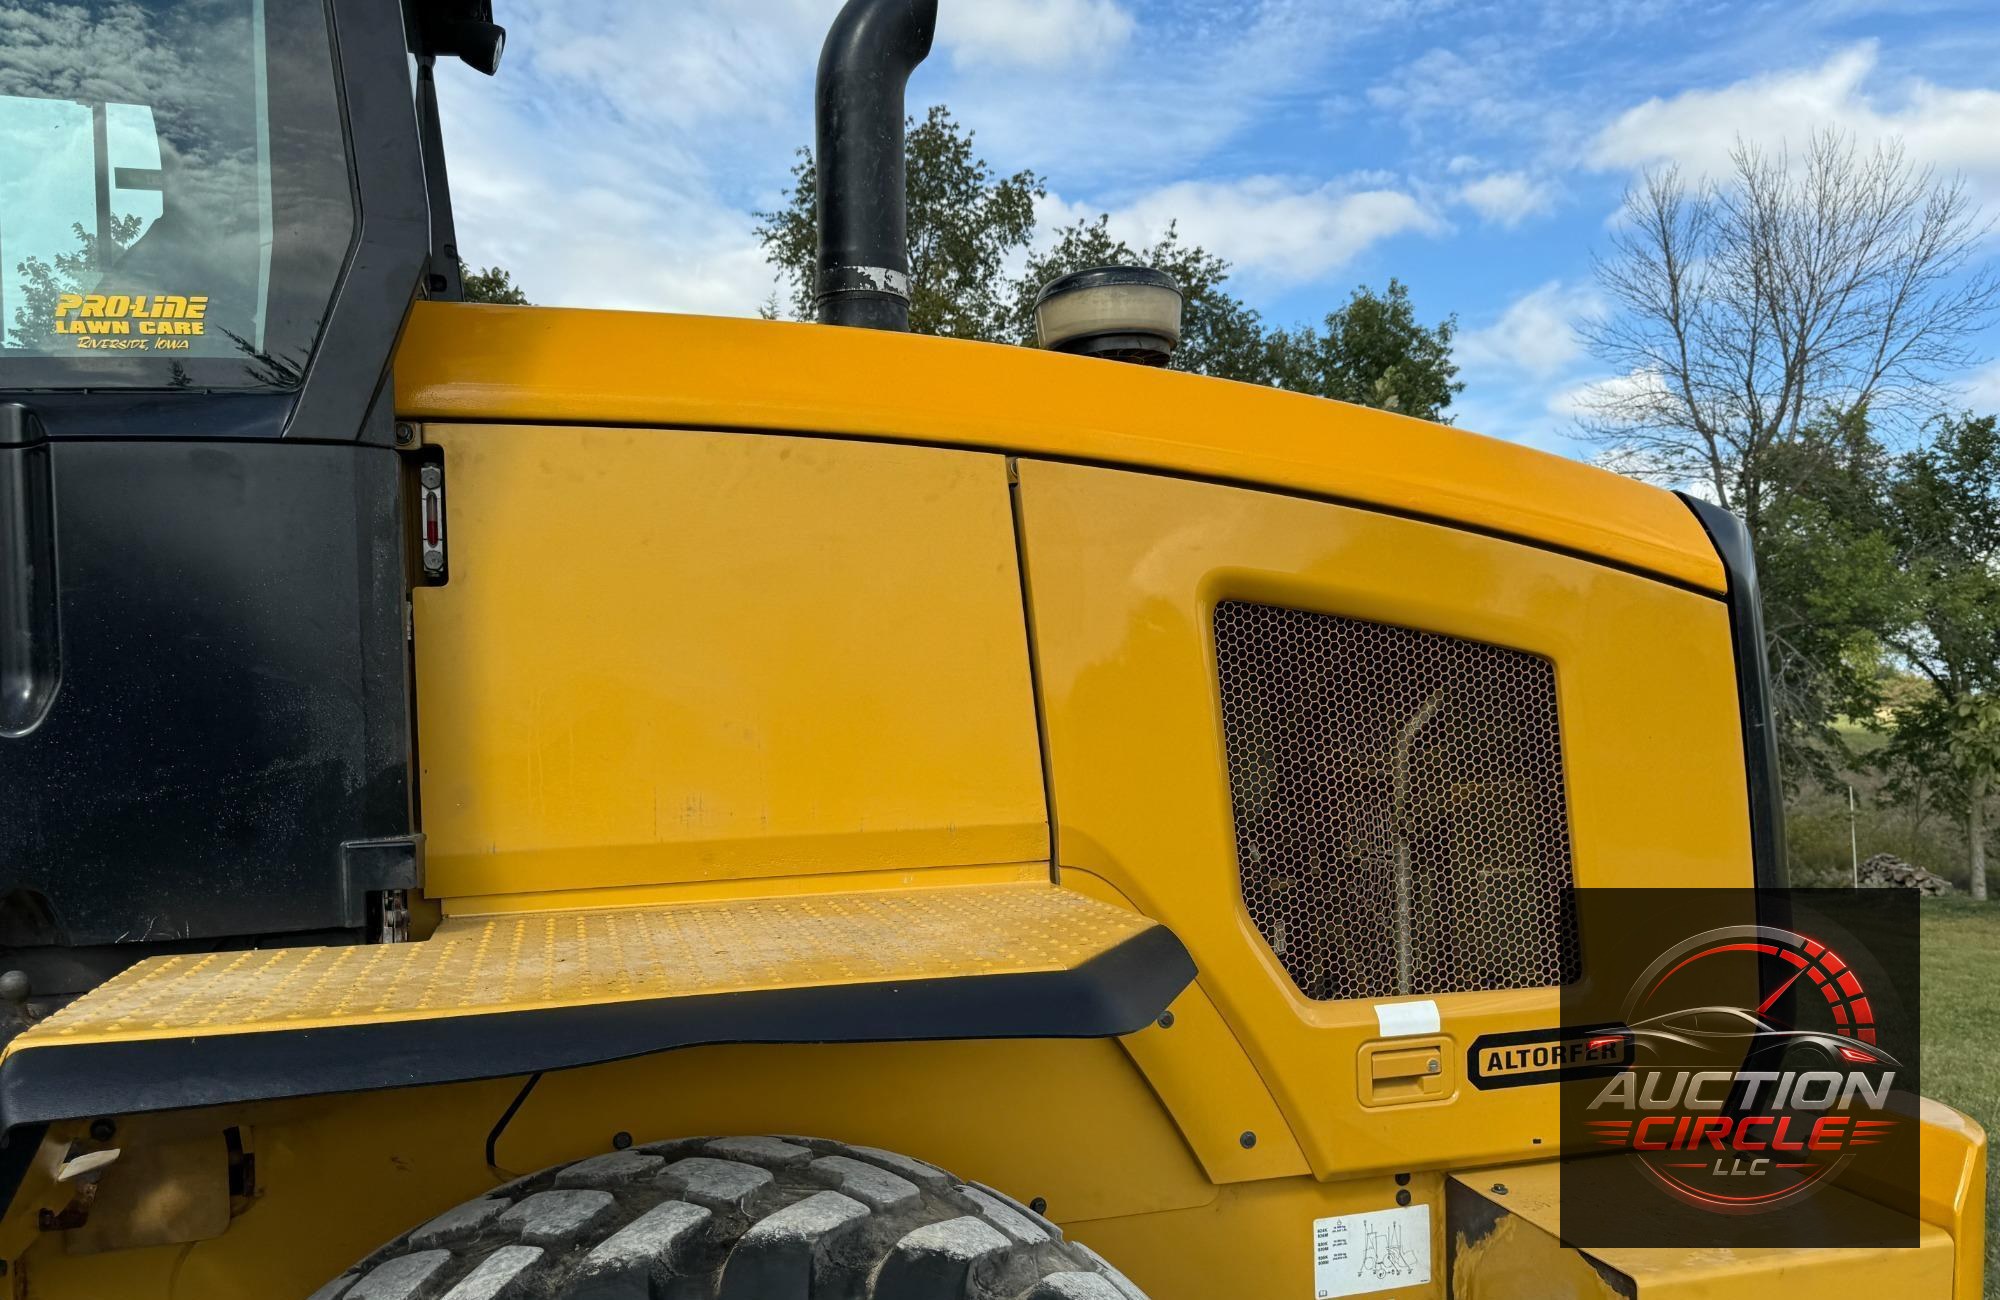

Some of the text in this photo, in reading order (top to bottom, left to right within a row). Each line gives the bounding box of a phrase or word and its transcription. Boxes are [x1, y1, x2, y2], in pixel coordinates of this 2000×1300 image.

[55, 294, 209, 319] PRO-LINE
[55, 321, 205, 335] LAWN CARE
[1487, 1038, 1617, 1072] ALTORFER
